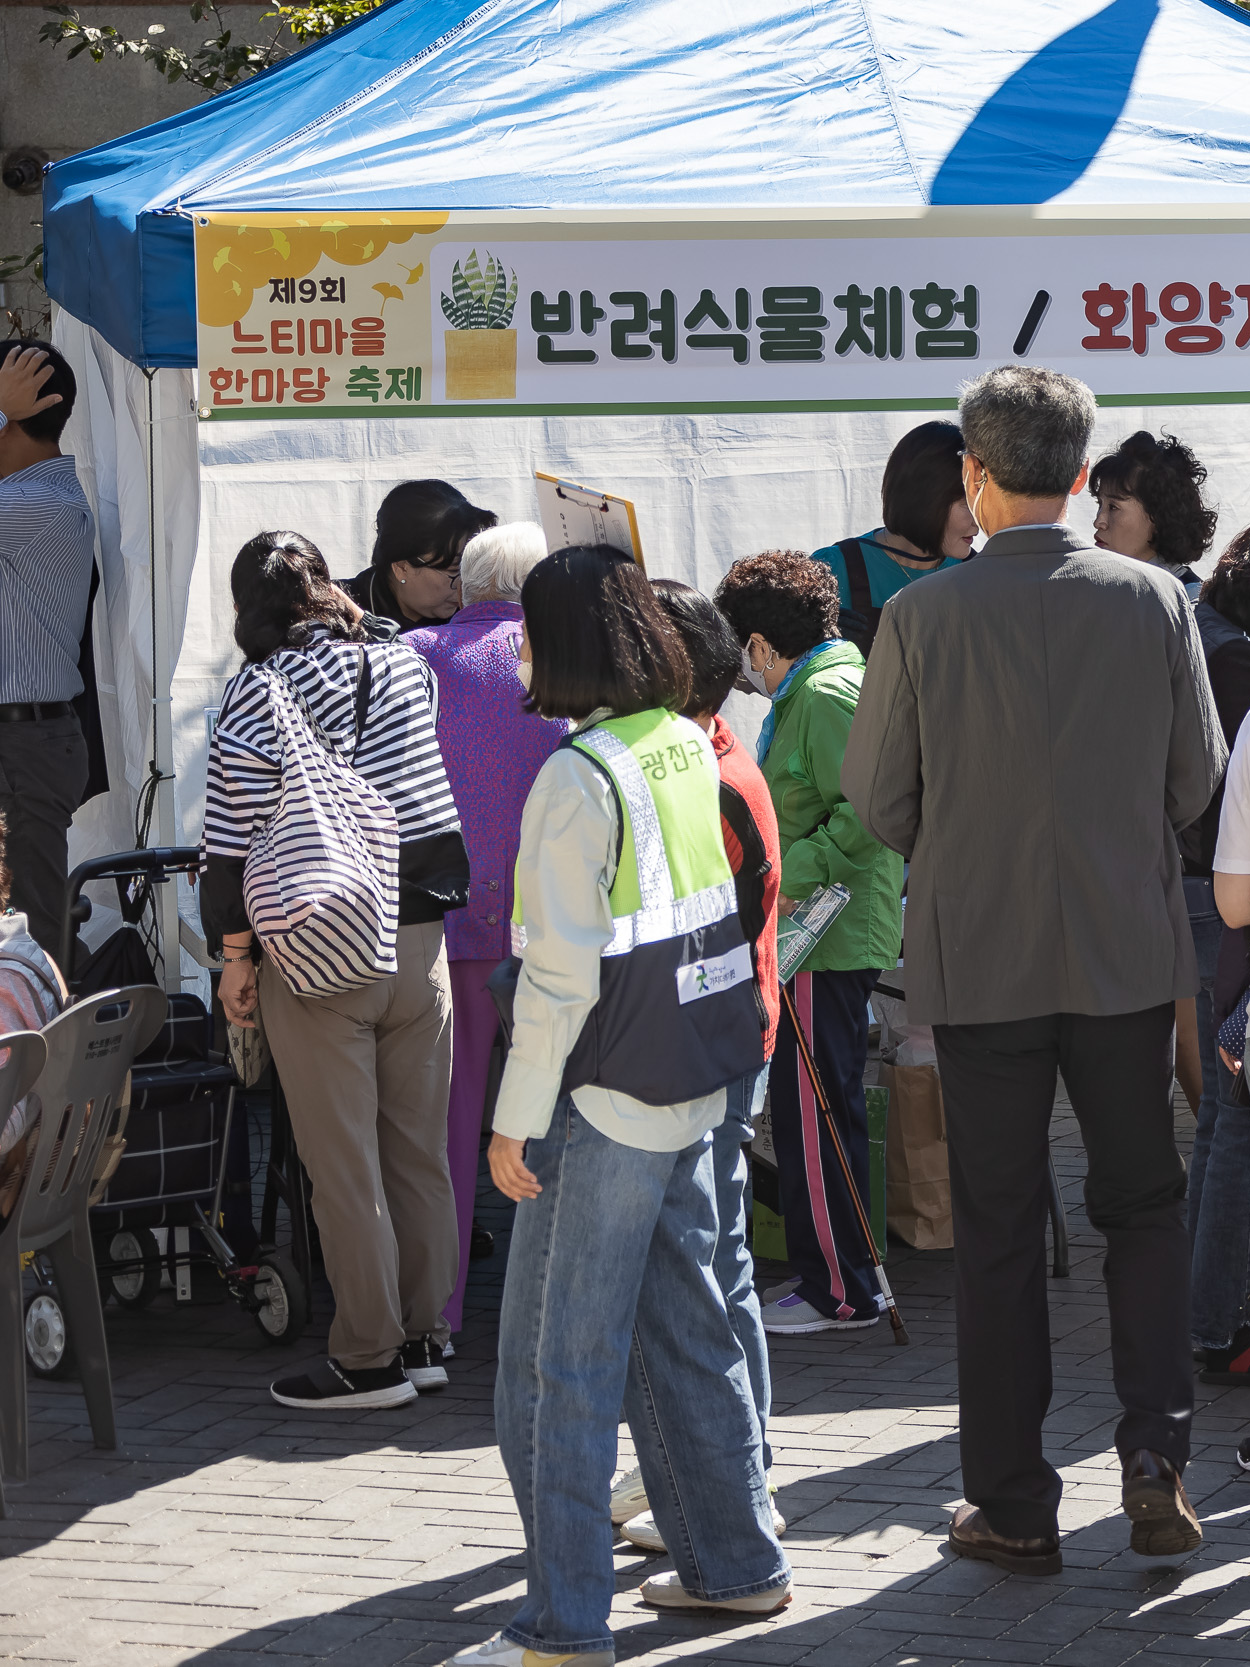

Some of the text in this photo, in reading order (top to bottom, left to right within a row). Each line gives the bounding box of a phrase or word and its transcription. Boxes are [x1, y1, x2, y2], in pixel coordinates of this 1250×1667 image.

[268, 276, 346, 304] 제9회
[231, 316, 387, 356] 느티마을
[530, 281, 981, 365] 반려식물체험
[1012, 289, 1052, 357] /
[208, 365, 422, 405] 한마당 축제
[640, 739, 704, 780] 광진구
